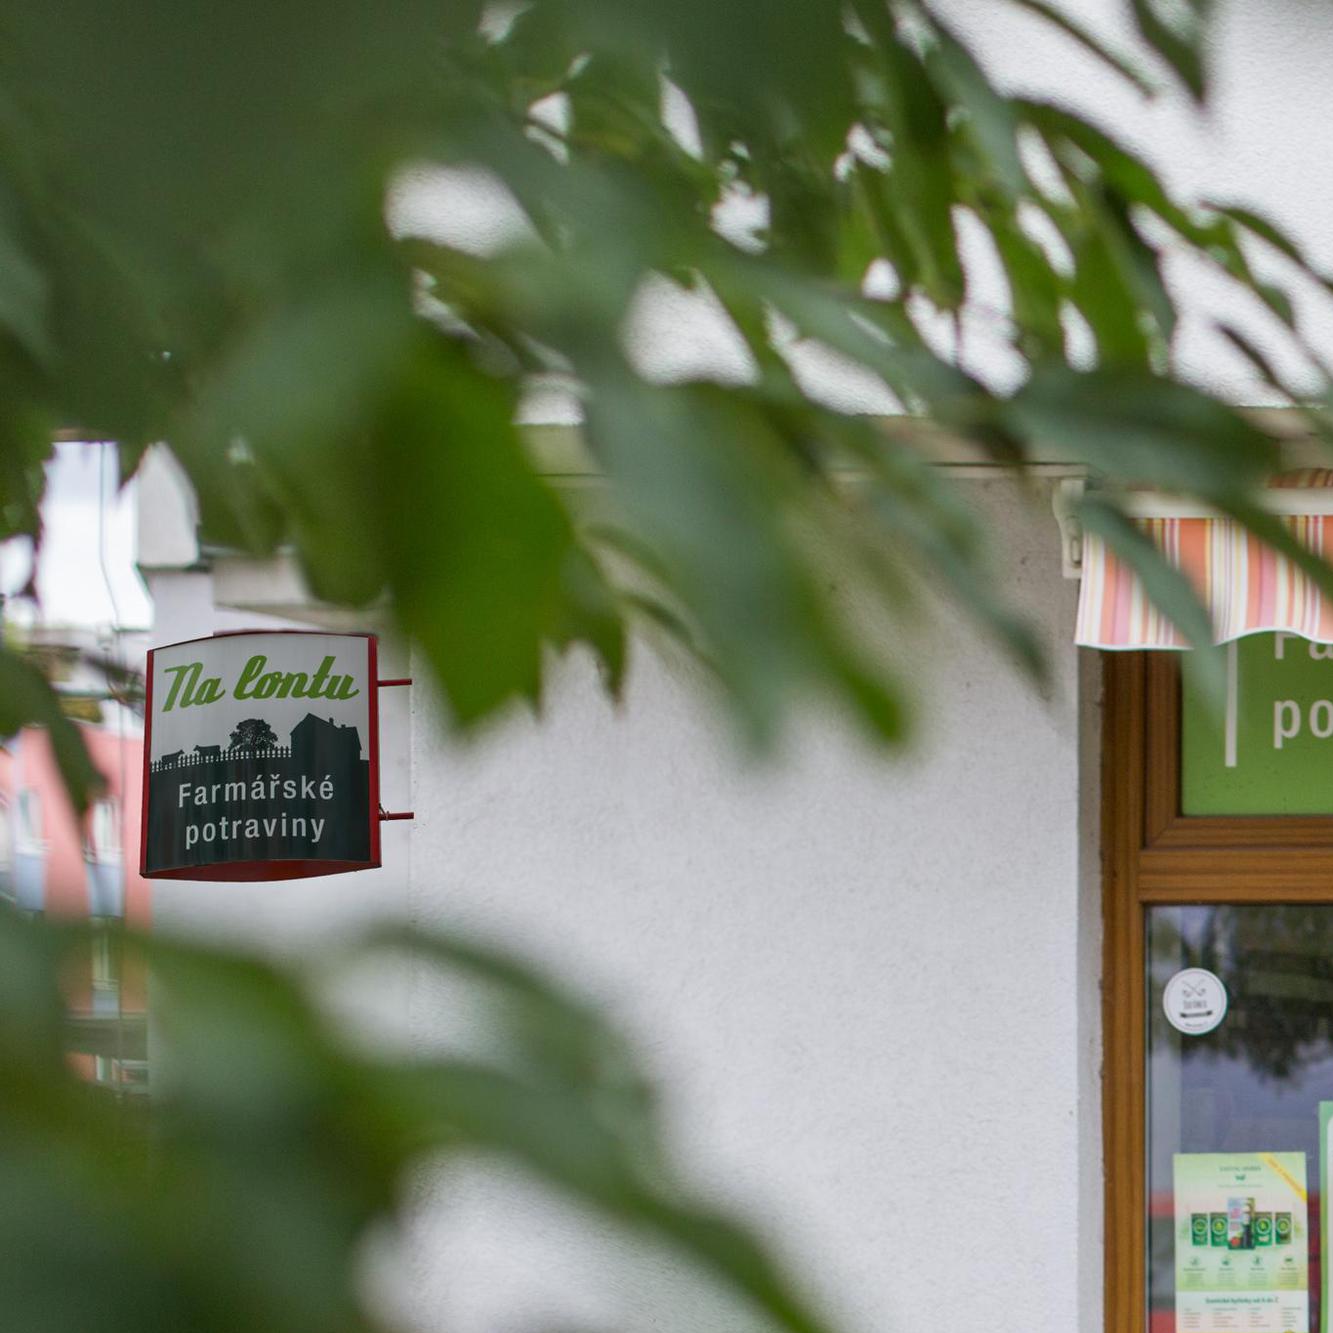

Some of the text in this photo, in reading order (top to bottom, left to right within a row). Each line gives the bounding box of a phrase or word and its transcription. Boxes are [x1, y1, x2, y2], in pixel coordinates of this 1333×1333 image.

[162, 661, 225, 712] Na
[178, 773, 335, 809] Farmářské
[185, 809, 326, 850] potraviny
